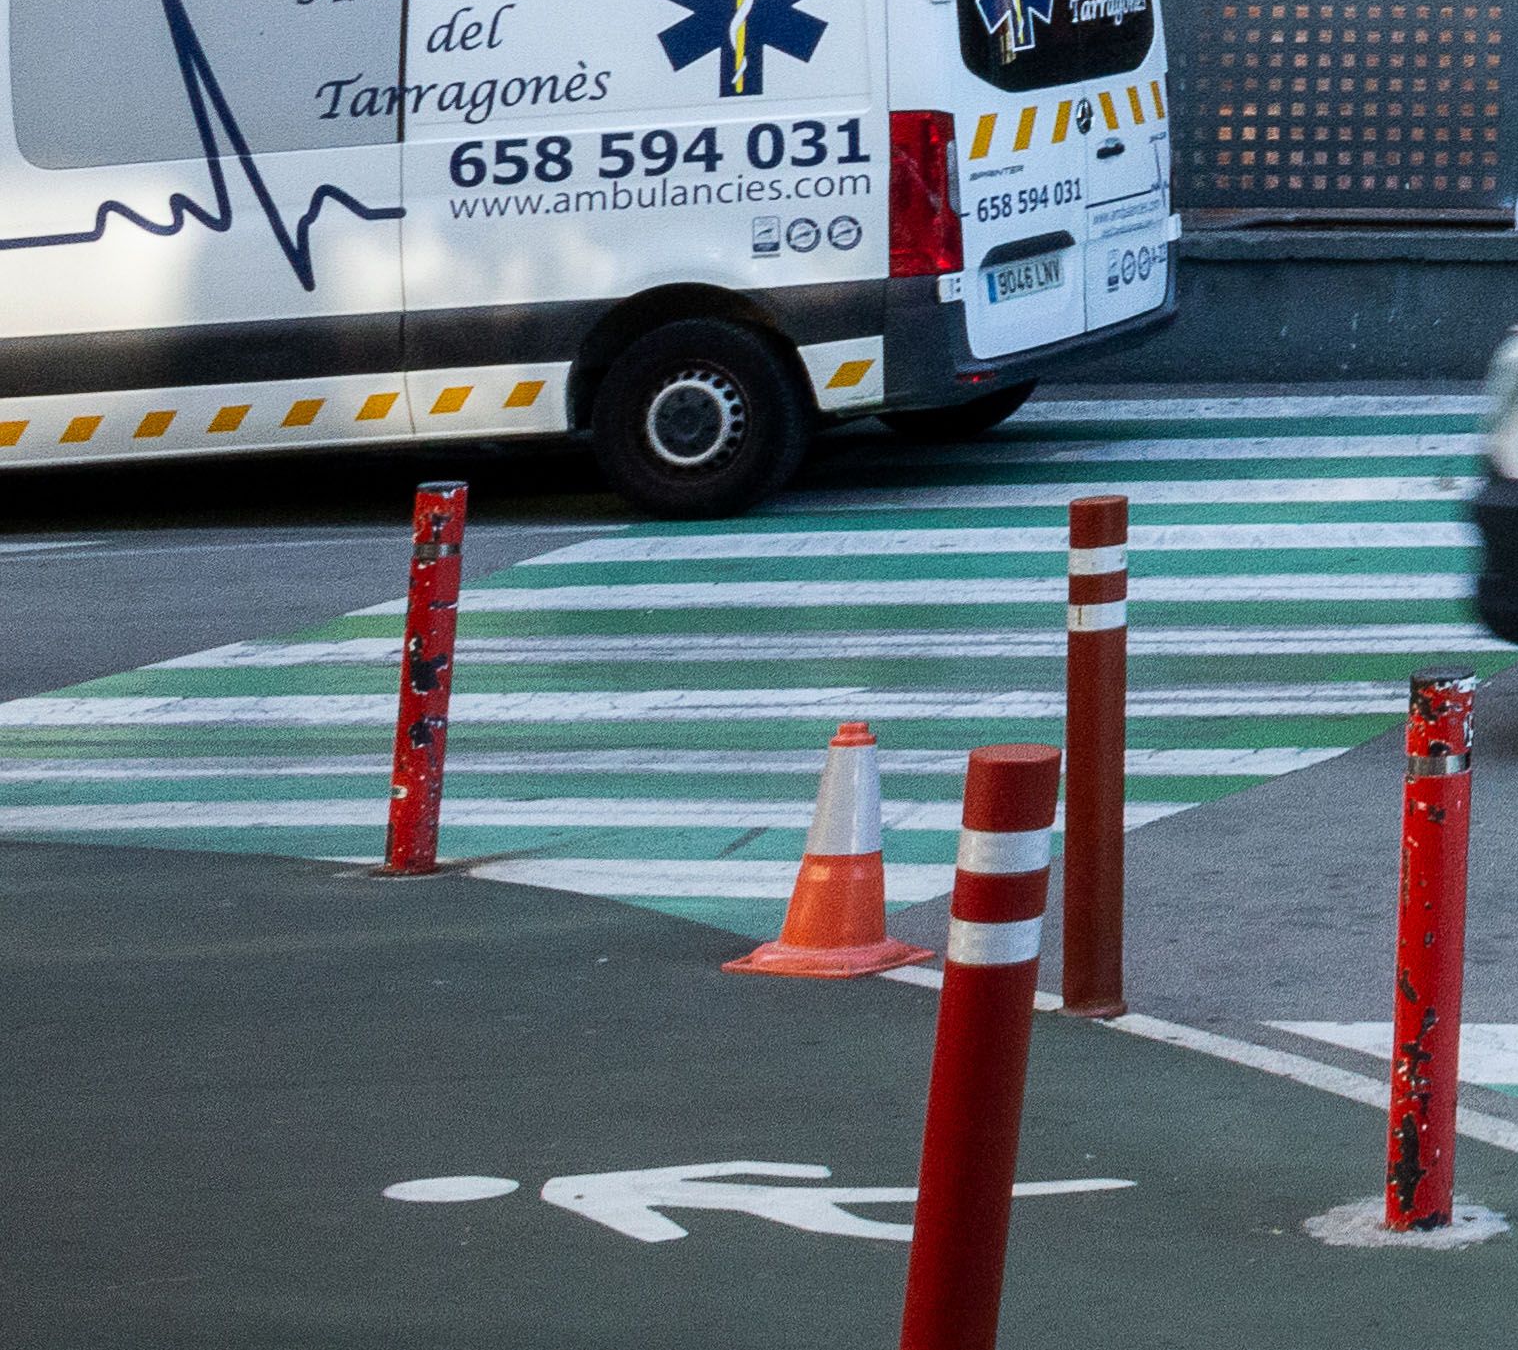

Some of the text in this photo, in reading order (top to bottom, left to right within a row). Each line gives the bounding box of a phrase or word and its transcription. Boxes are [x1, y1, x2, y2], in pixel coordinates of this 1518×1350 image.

[426, 2, 516, 54] del
[315, 59, 612, 124] Tarragonès
[449, 117, 871, 188] 658 594 031
[449, 172, 872, 219] www.ambulancies.com
[977, 177, 1083, 223] 658 594 031
[998, 265, 1034, 296] 9046
